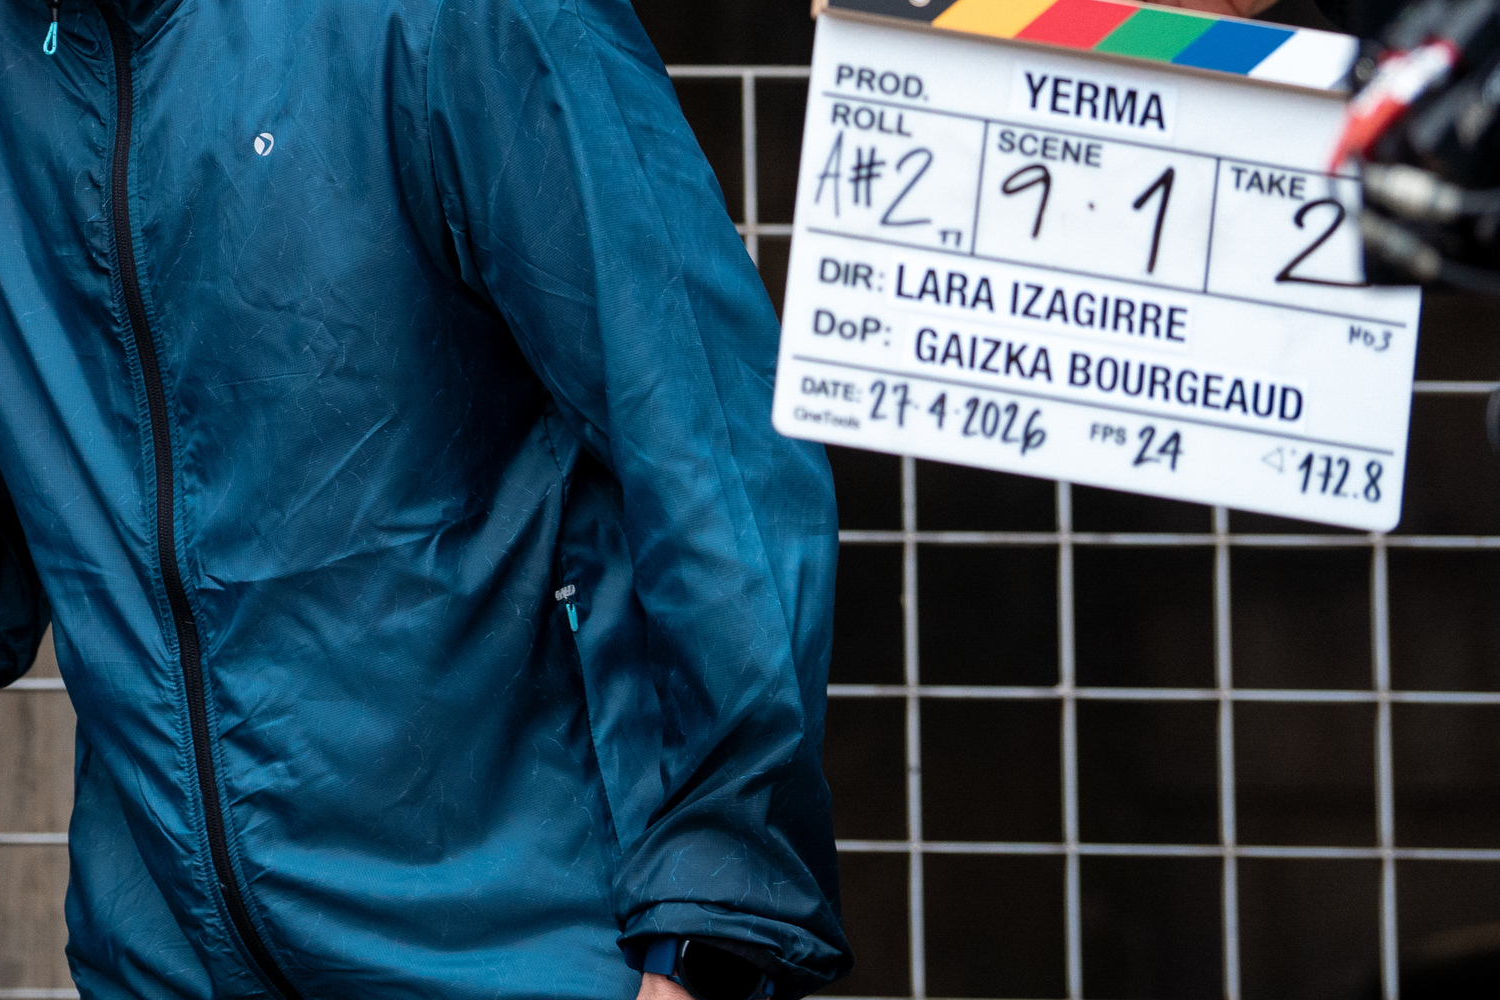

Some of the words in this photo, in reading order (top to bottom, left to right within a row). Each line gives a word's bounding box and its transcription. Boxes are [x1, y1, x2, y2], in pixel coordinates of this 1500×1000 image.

[830, 103, 913, 138] ROLL
[1024, 71, 1167, 131] YERMA
[998, 129, 1103, 168] SCENE
[1231, 166, 1306, 201] TAKE
[1274, 197, 1371, 288] 2
[818, 257, 885, 293] DIR:
[895, 263, 994, 312] LARA
[1010, 281, 1188, 342] IZAGIRRE
[800, 376, 862, 404] DATE:
[812, 309, 892, 348] DoP:
[915, 327, 1052, 384] GAIZKA
[1068, 352, 1304, 423] BOURGEAUD
[1090, 422, 1127, 446] FPS
[1132, 425, 1184, 473] 24
[1298, 451, 1384, 504] 172.8
